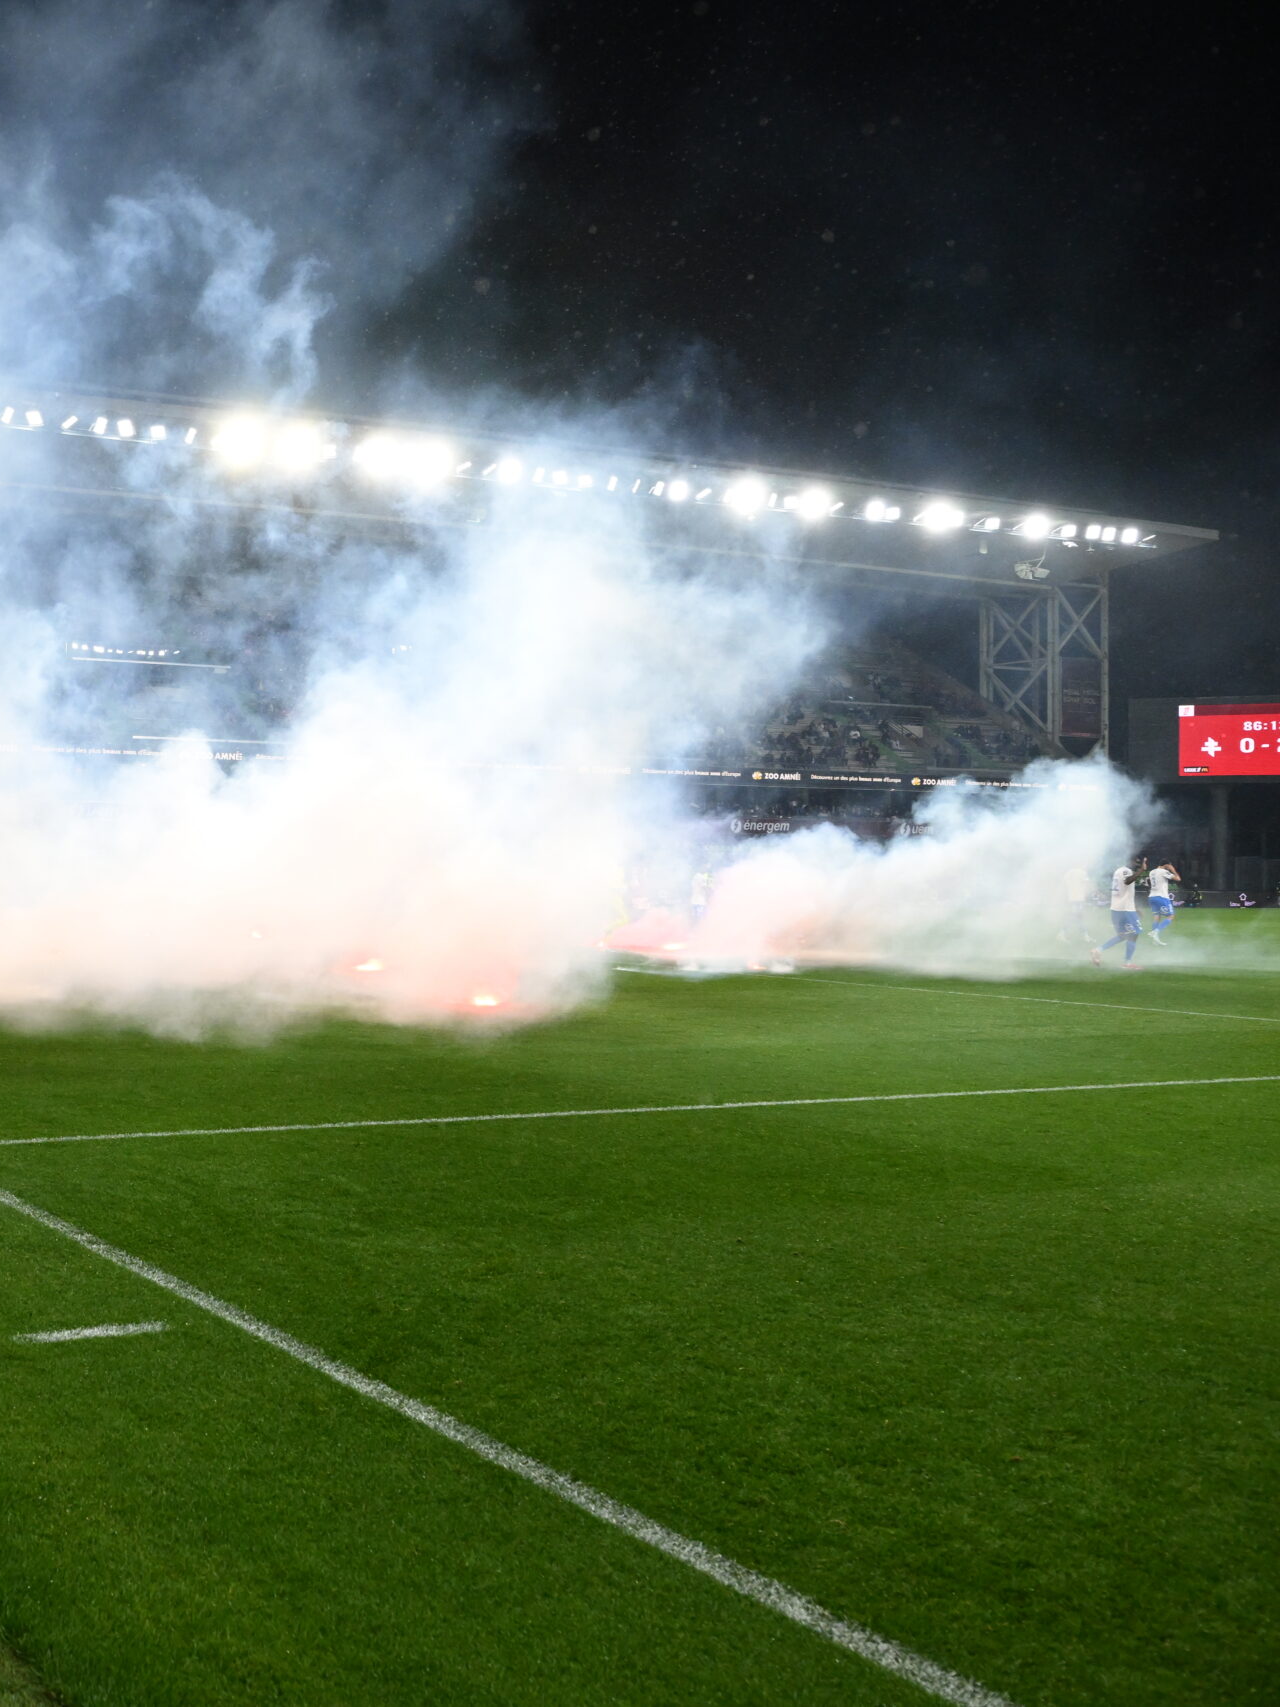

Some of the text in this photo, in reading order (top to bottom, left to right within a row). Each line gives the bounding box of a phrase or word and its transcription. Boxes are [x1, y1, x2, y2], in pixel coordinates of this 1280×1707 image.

[1242, 720, 1280, 731] 86:1
[1239, 737, 1255, 753] 0
[764, 772, 779, 780] ZOO
[922, 778, 935, 786] ZOO
[743, 819, 790, 834] énergem
